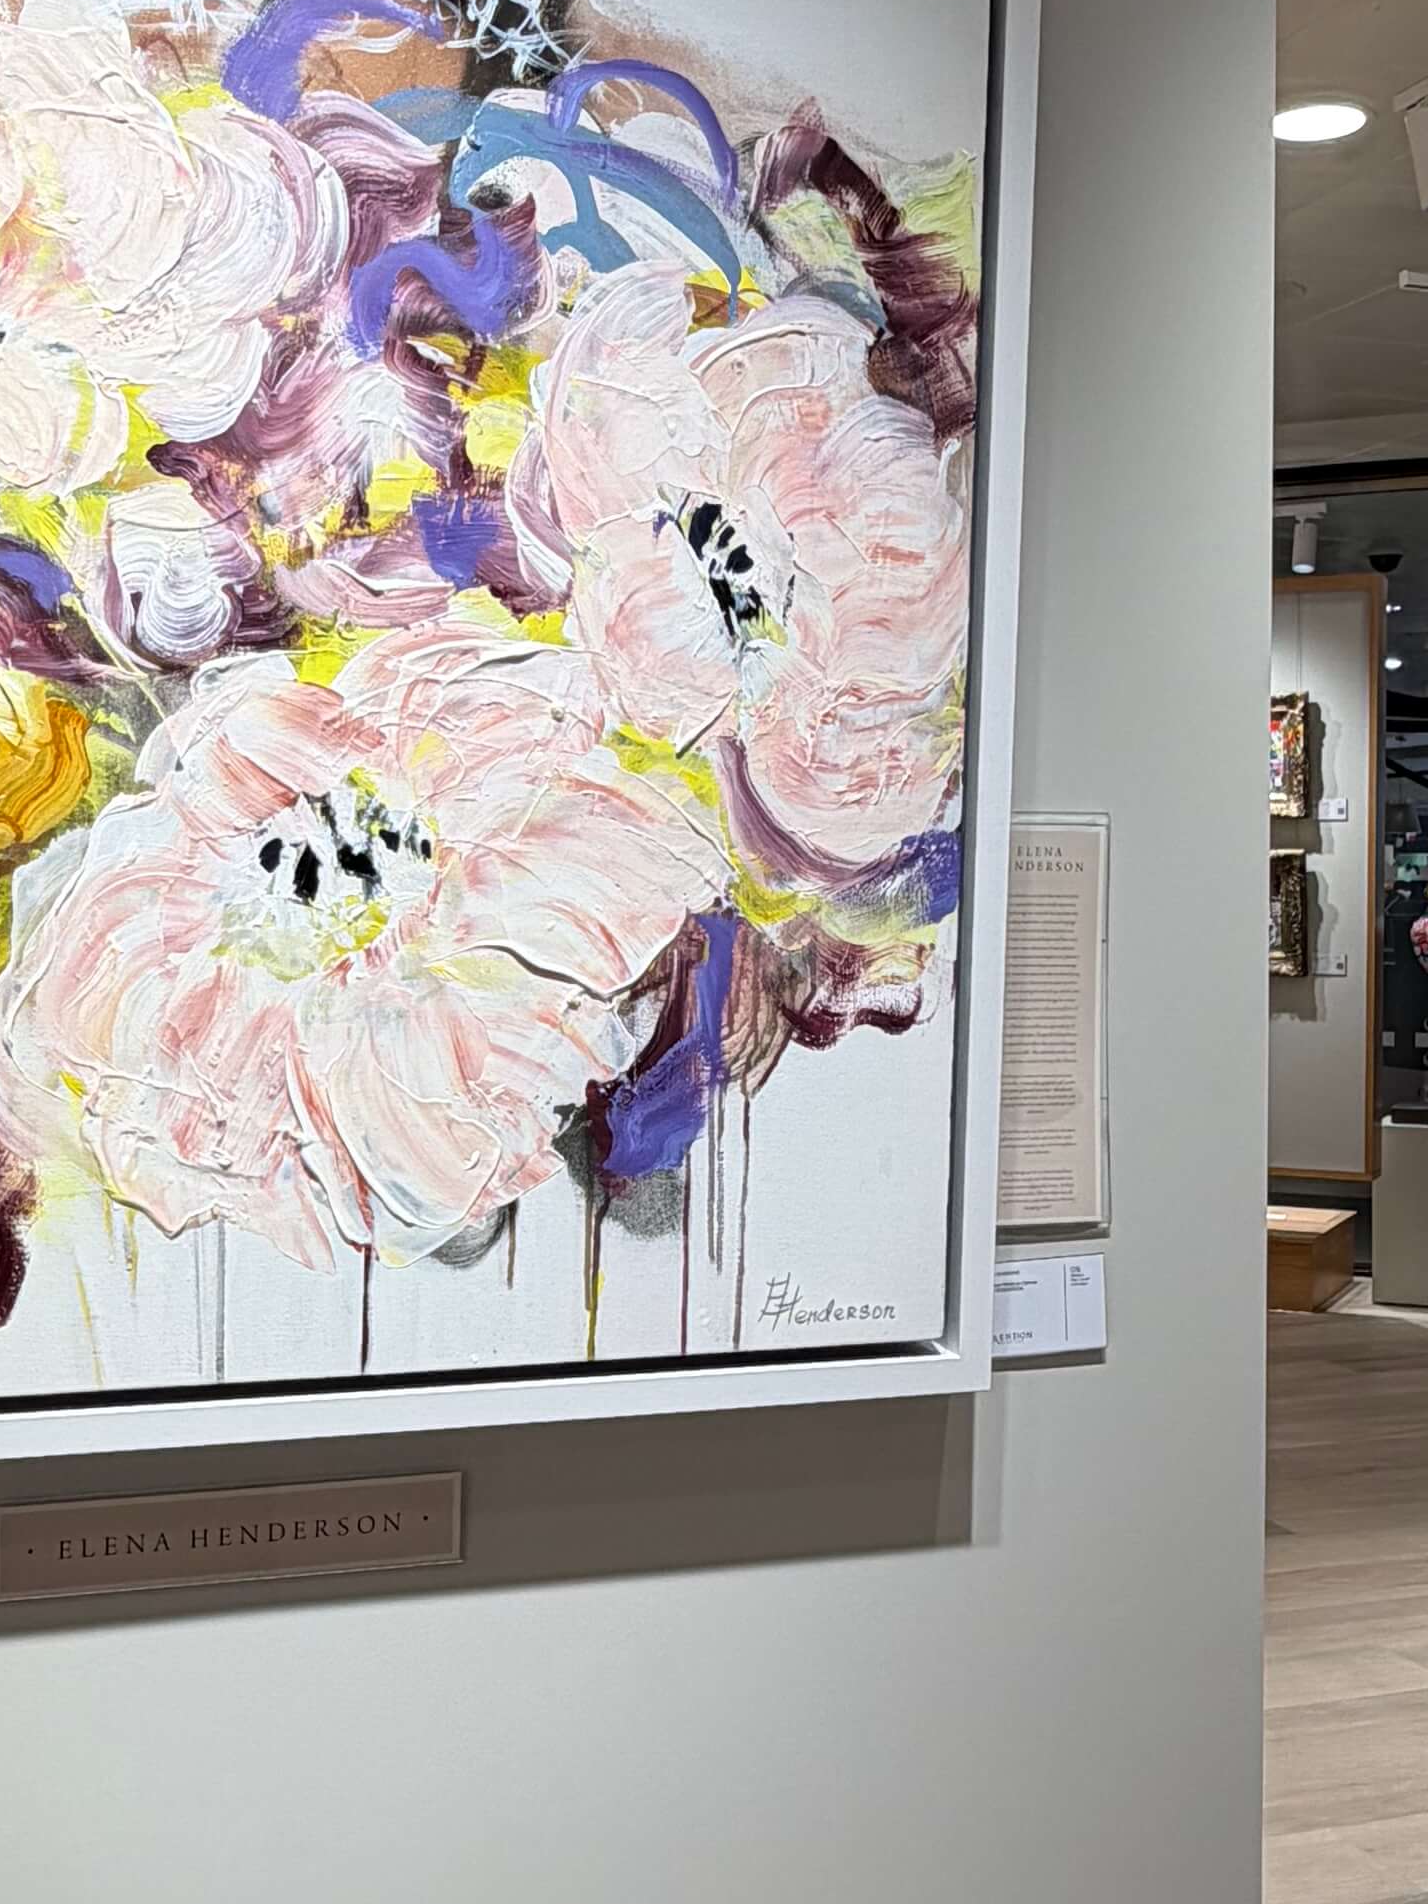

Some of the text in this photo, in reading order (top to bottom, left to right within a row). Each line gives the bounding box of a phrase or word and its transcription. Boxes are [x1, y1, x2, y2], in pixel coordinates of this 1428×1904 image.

[1017, 846, 1062, 857] ELENA
[1015, 861, 1084, 873] NDERSON
[59, 1512, 402, 1560] ELENA HENDERSON
